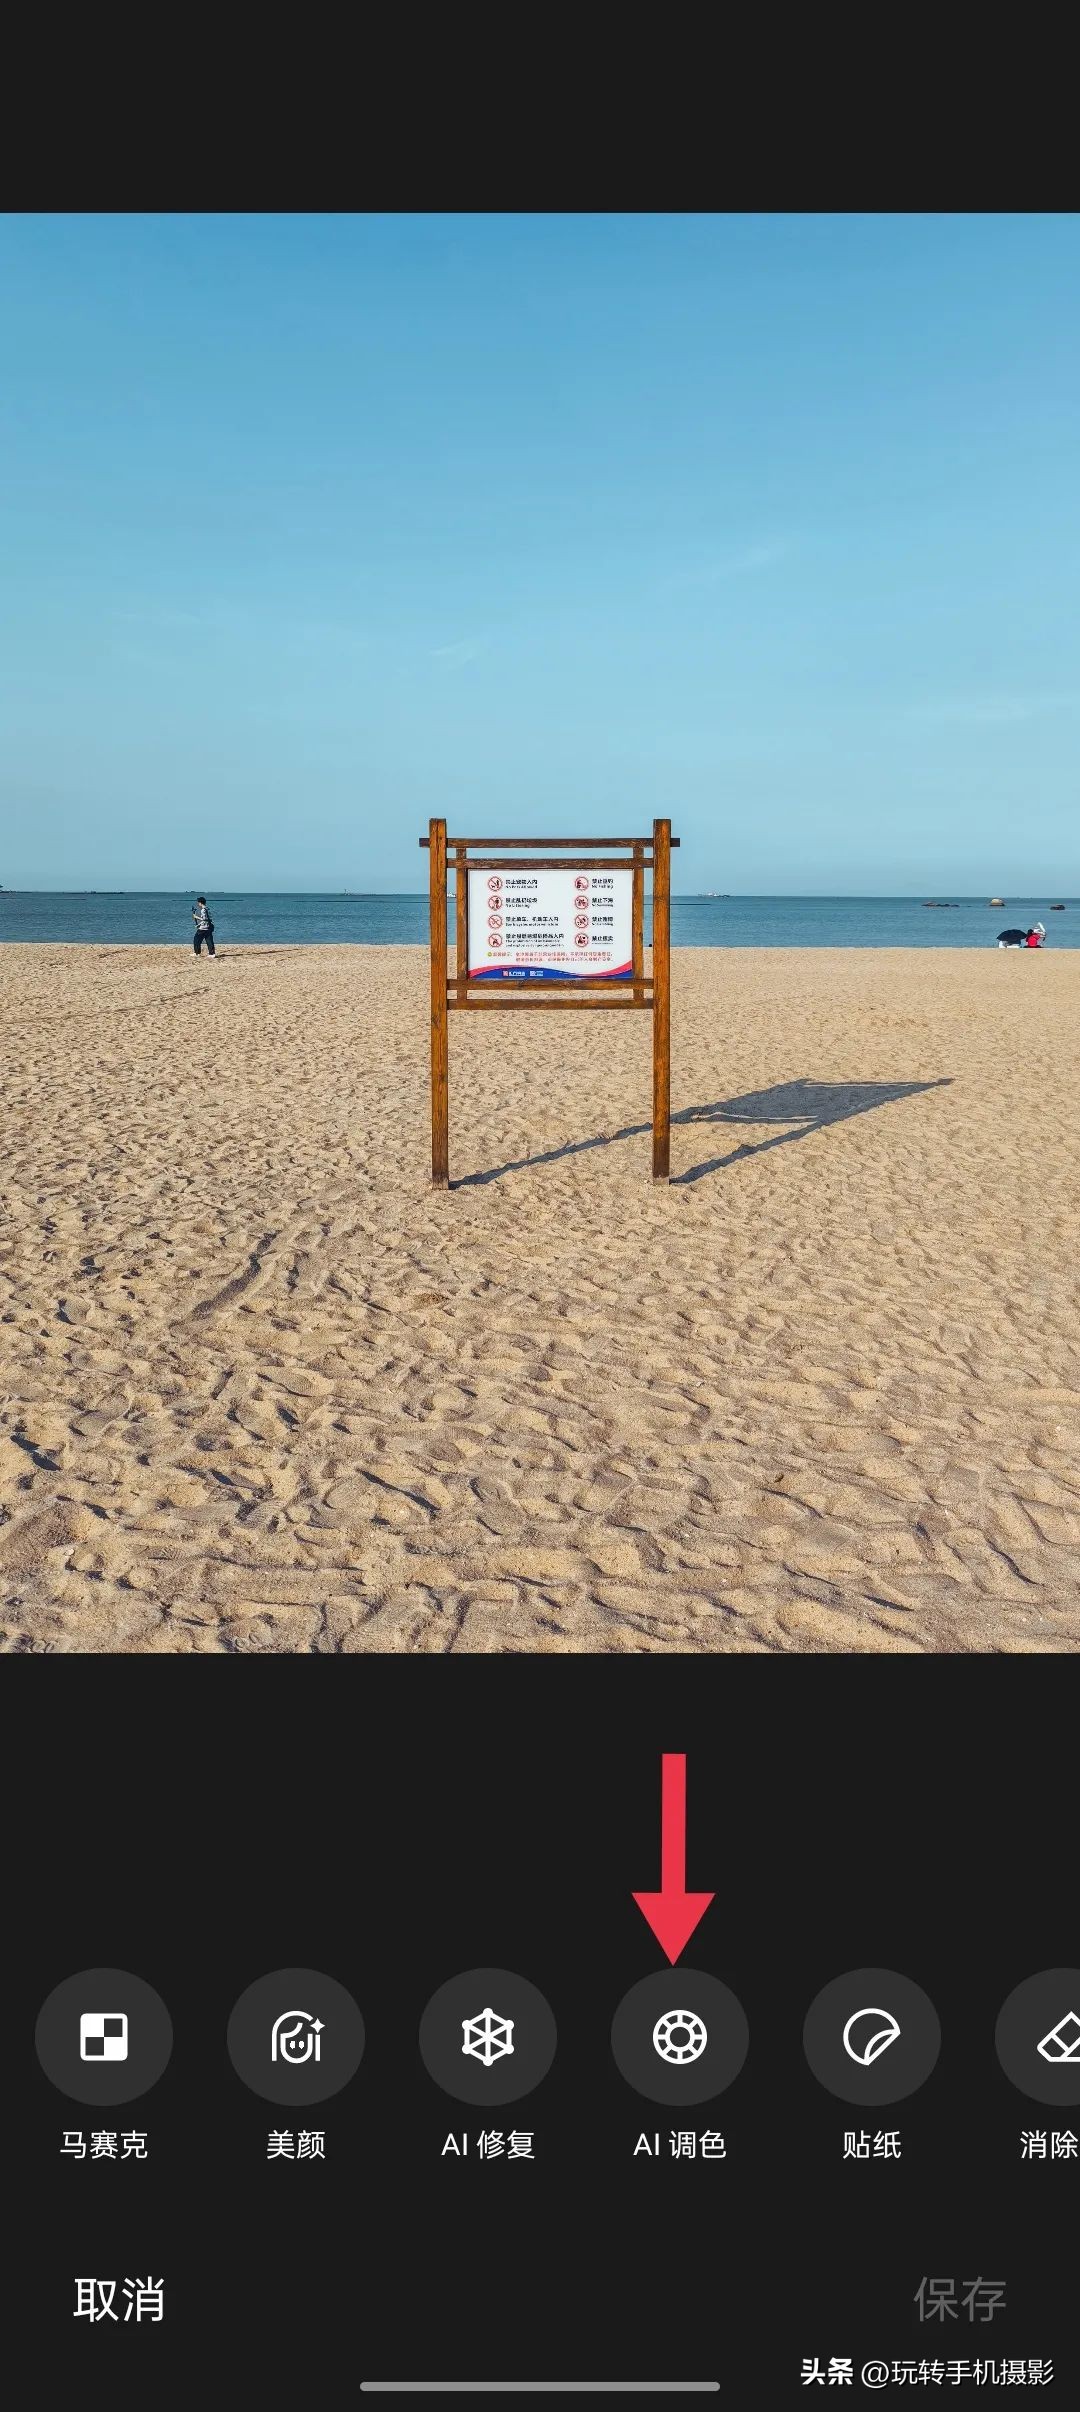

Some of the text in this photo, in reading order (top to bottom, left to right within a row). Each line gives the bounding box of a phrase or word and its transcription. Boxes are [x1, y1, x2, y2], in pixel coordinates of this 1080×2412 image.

[60, 2130, 148, 2160] 马赛克
[267, 2130, 325, 2160] 美颜
[441, 2130, 535, 2160] AI 修复
[633, 2130, 727, 2160] AI 调色
[843, 2130, 901, 2160] 贴纸
[1020, 2130, 1079, 2160] 消除
[73, 2276, 164, 2322] 取消
[913, 2276, 1007, 2322] 保存
